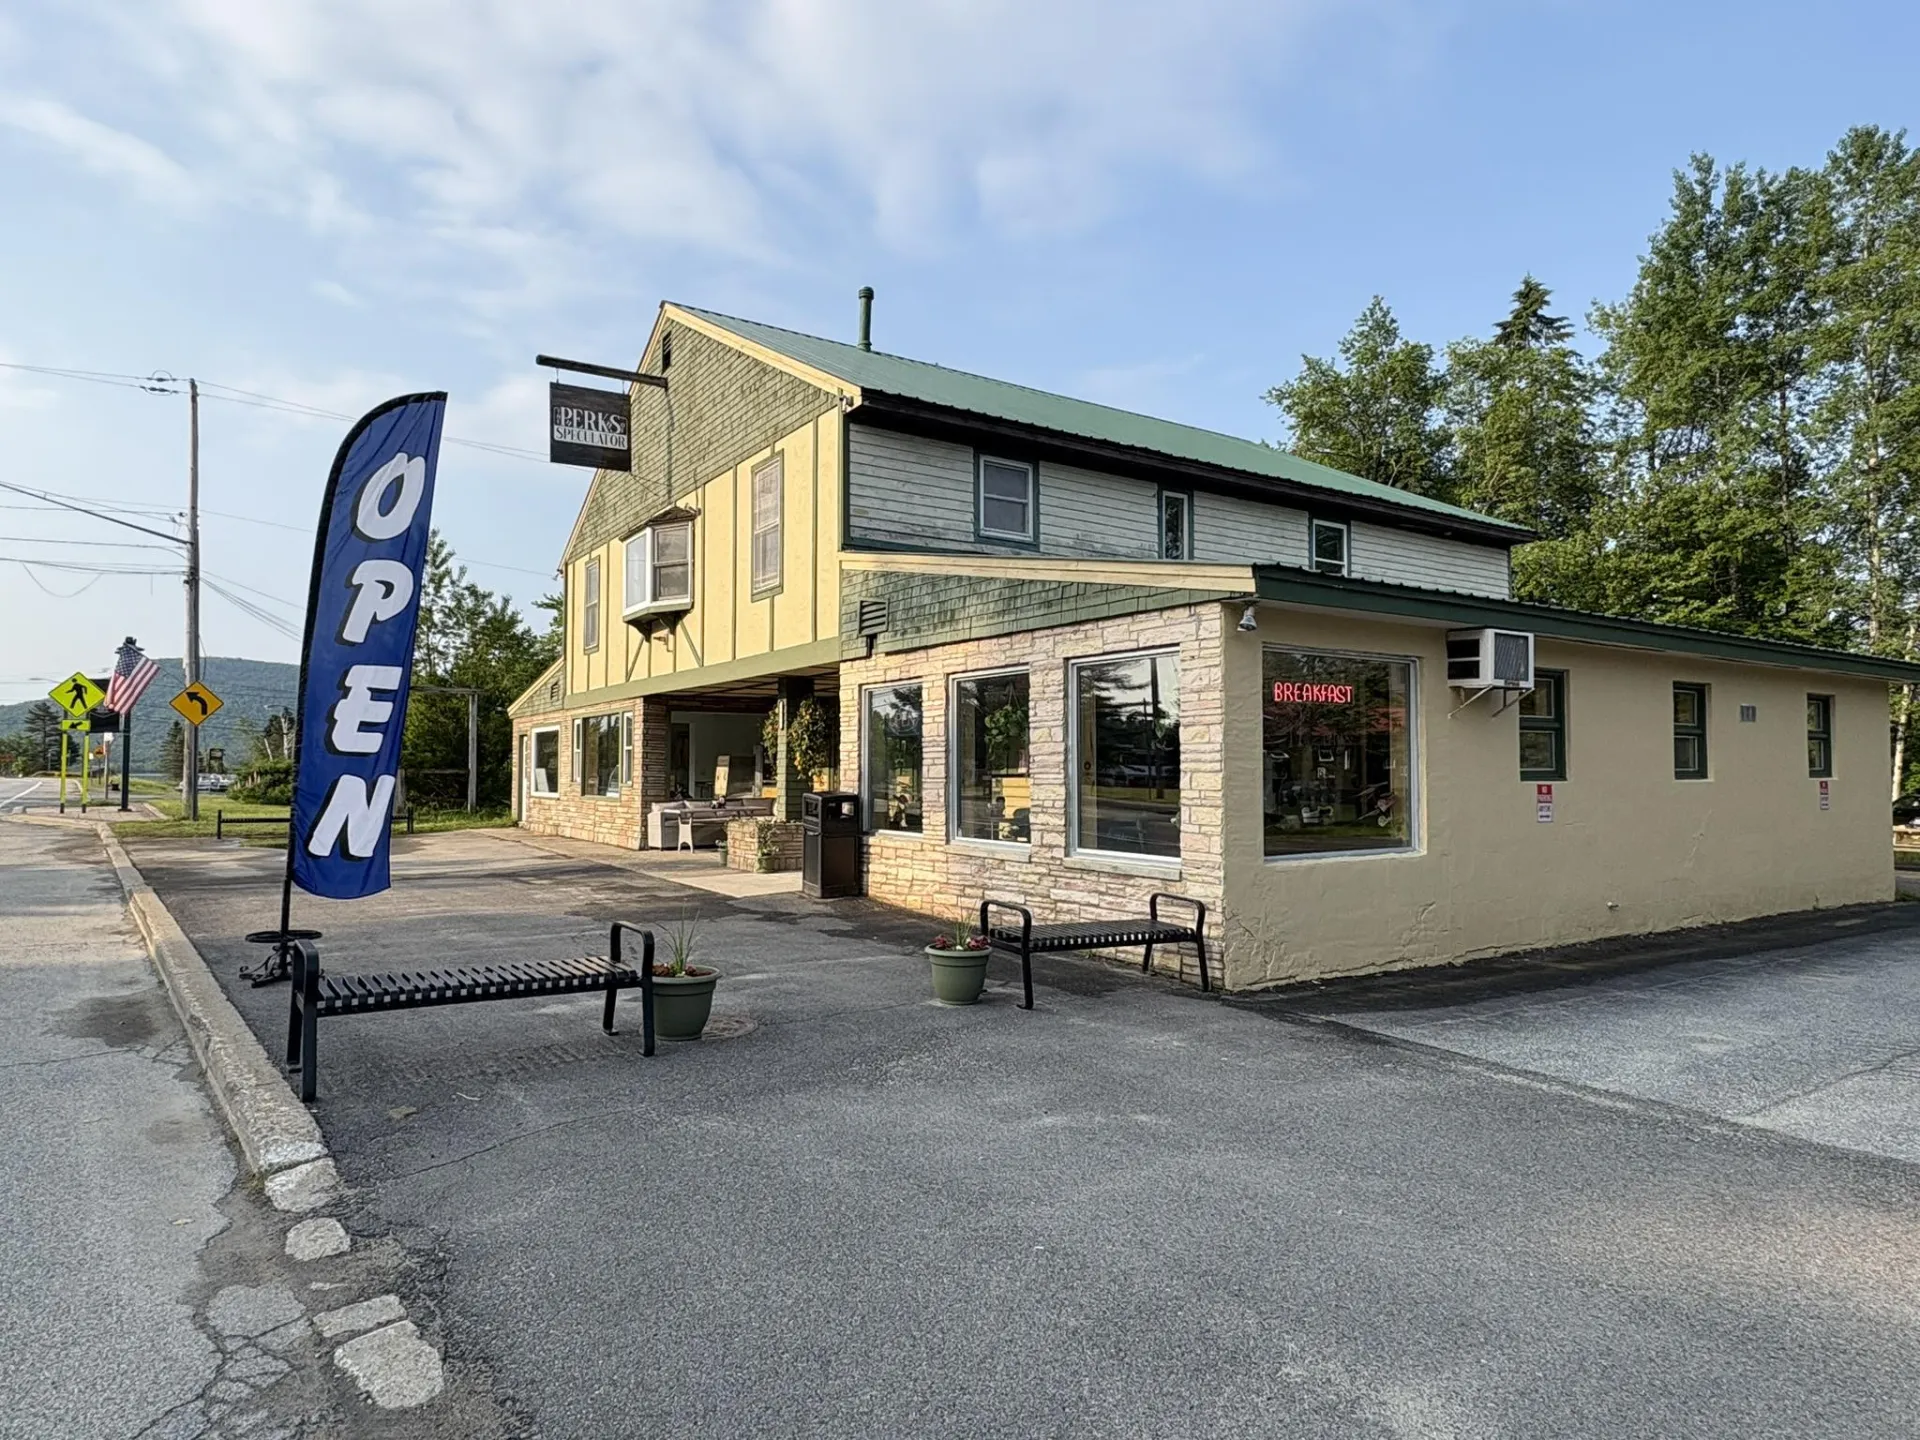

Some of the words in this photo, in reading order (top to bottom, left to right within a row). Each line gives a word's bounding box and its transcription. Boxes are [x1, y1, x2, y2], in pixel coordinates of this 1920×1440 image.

[560, 406, 621, 434] PERKS
[555, 426, 626, 449] SPECULATOR
[307, 452, 426, 859] OPEN
[1274, 681, 1352, 703] BREAKFAST
